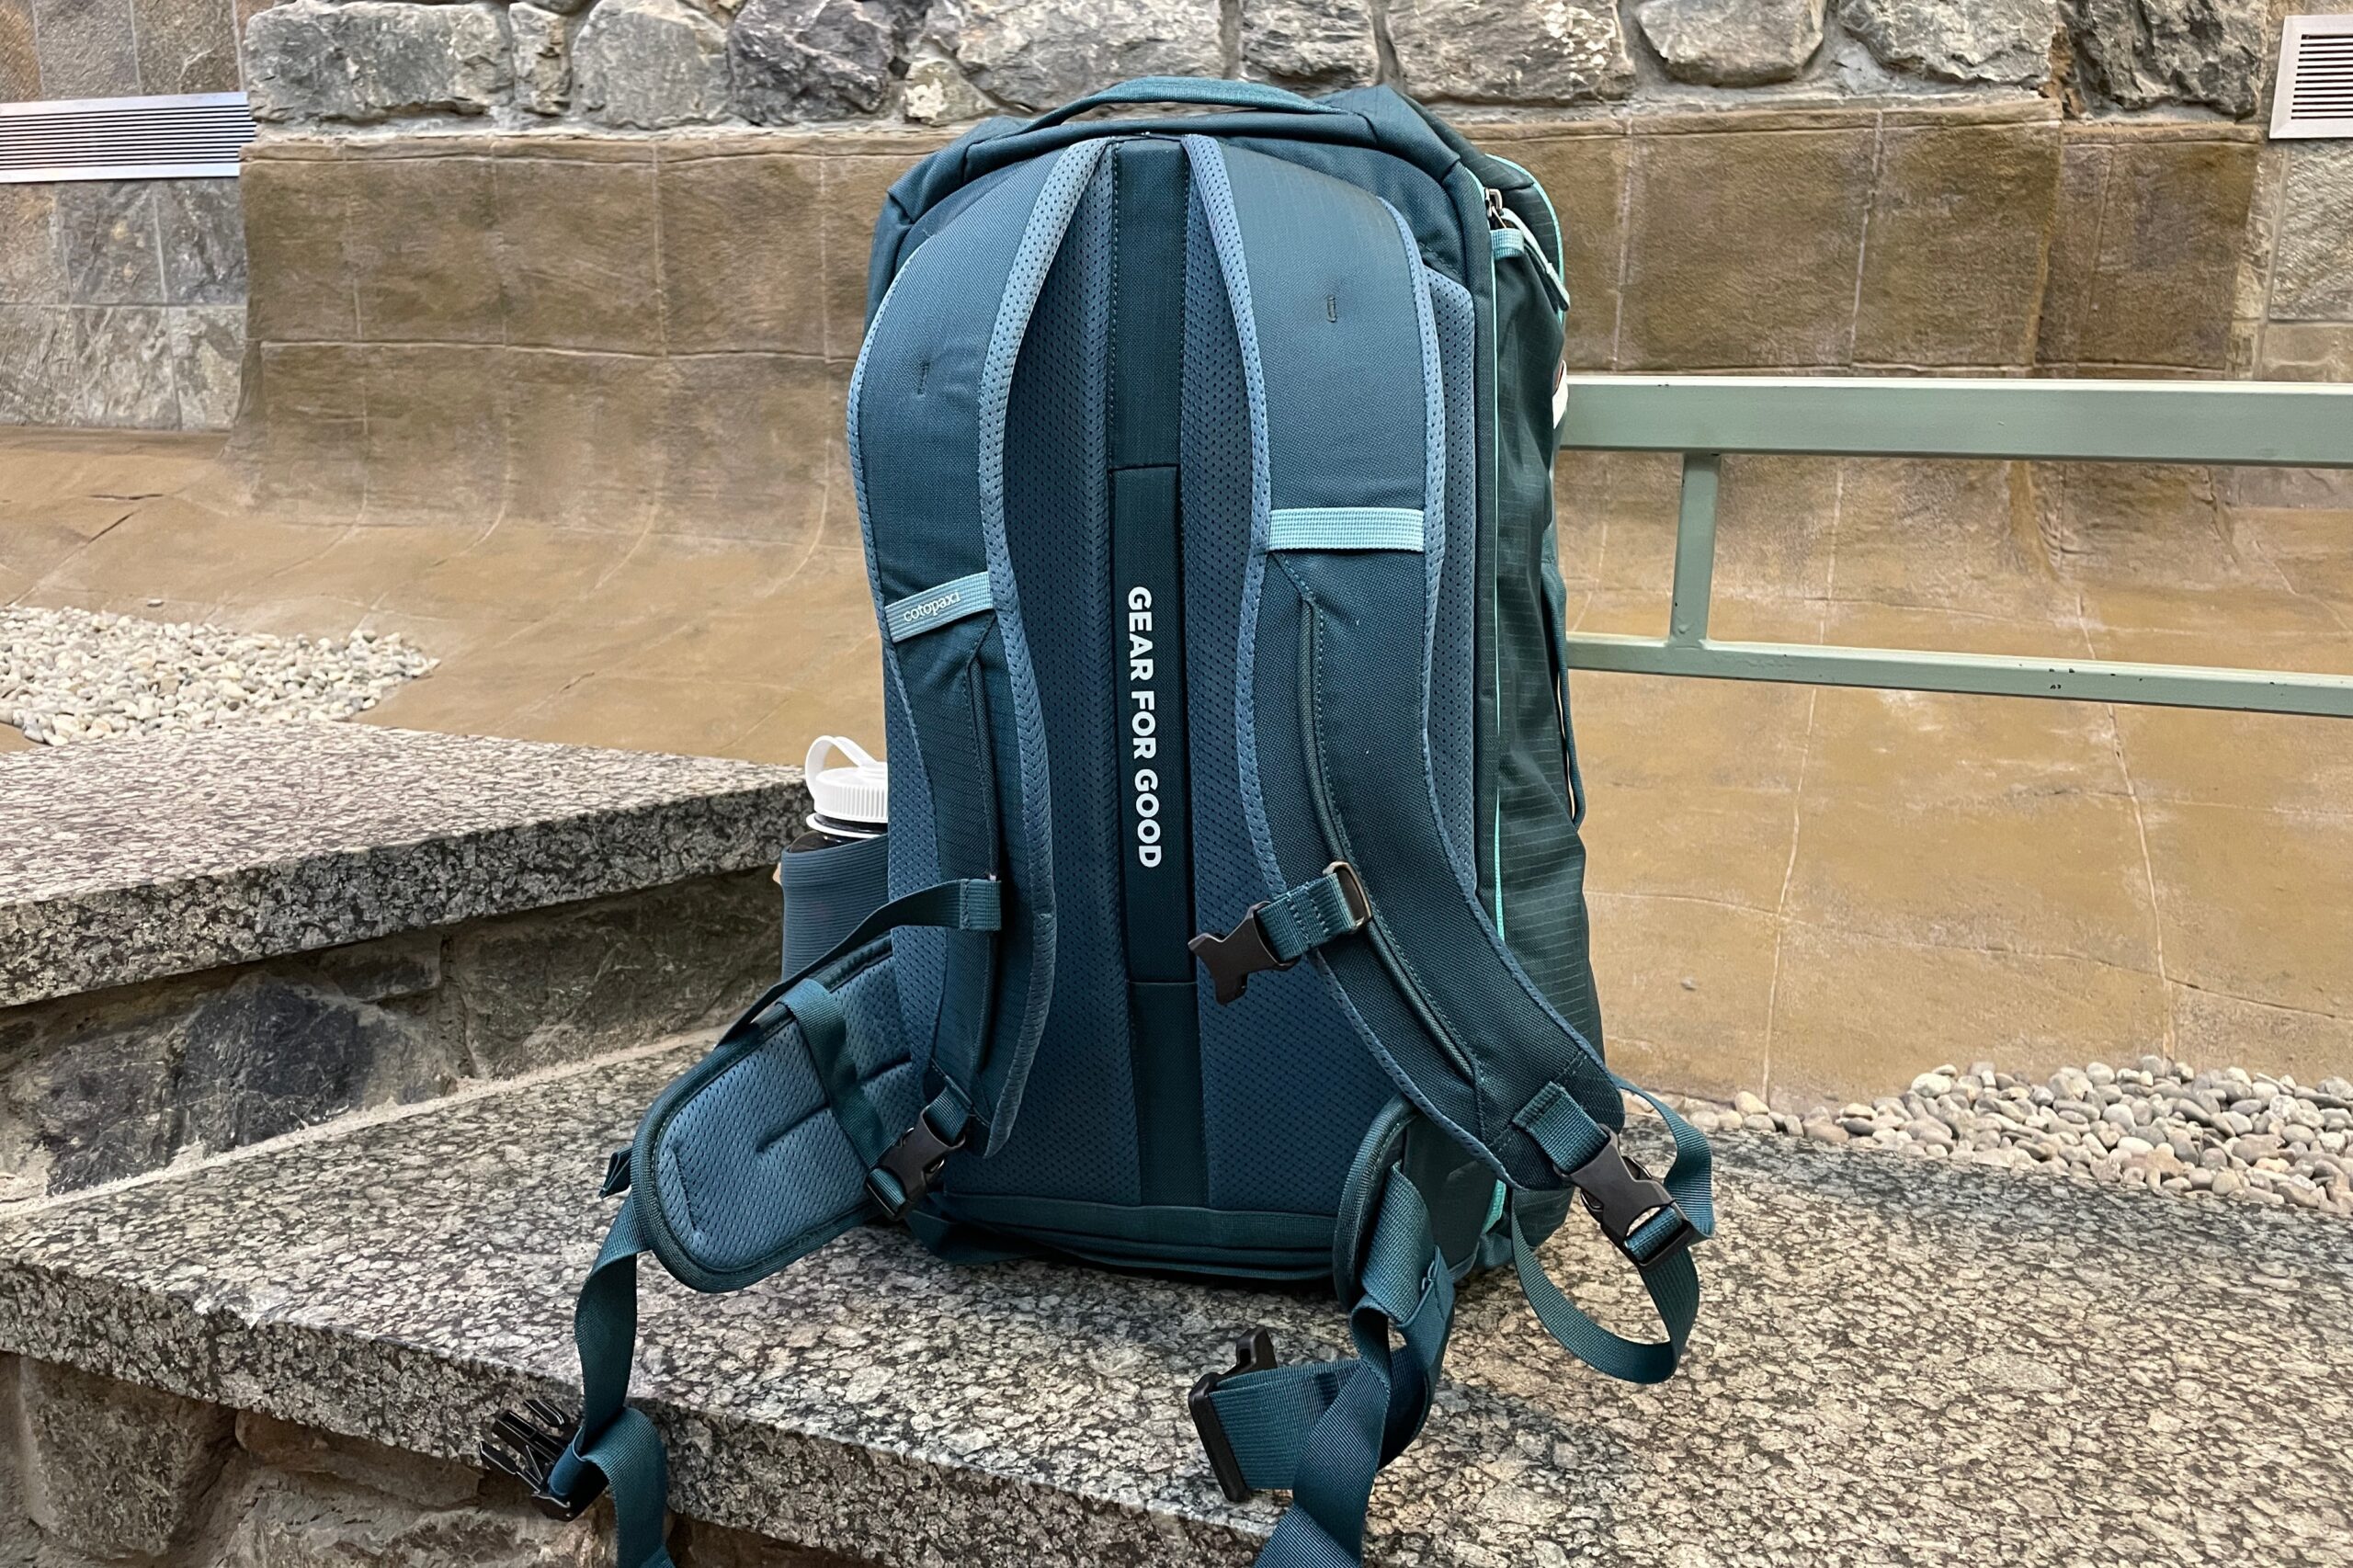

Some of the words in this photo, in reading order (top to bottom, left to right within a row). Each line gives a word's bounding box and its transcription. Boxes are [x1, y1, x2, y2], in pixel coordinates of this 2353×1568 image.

[903, 592, 961, 622] cotopaxi
[1129, 586, 1154, 681] GEAR
[1131, 690, 1157, 759] FOR
[1135, 768, 1162, 868] GOOD
